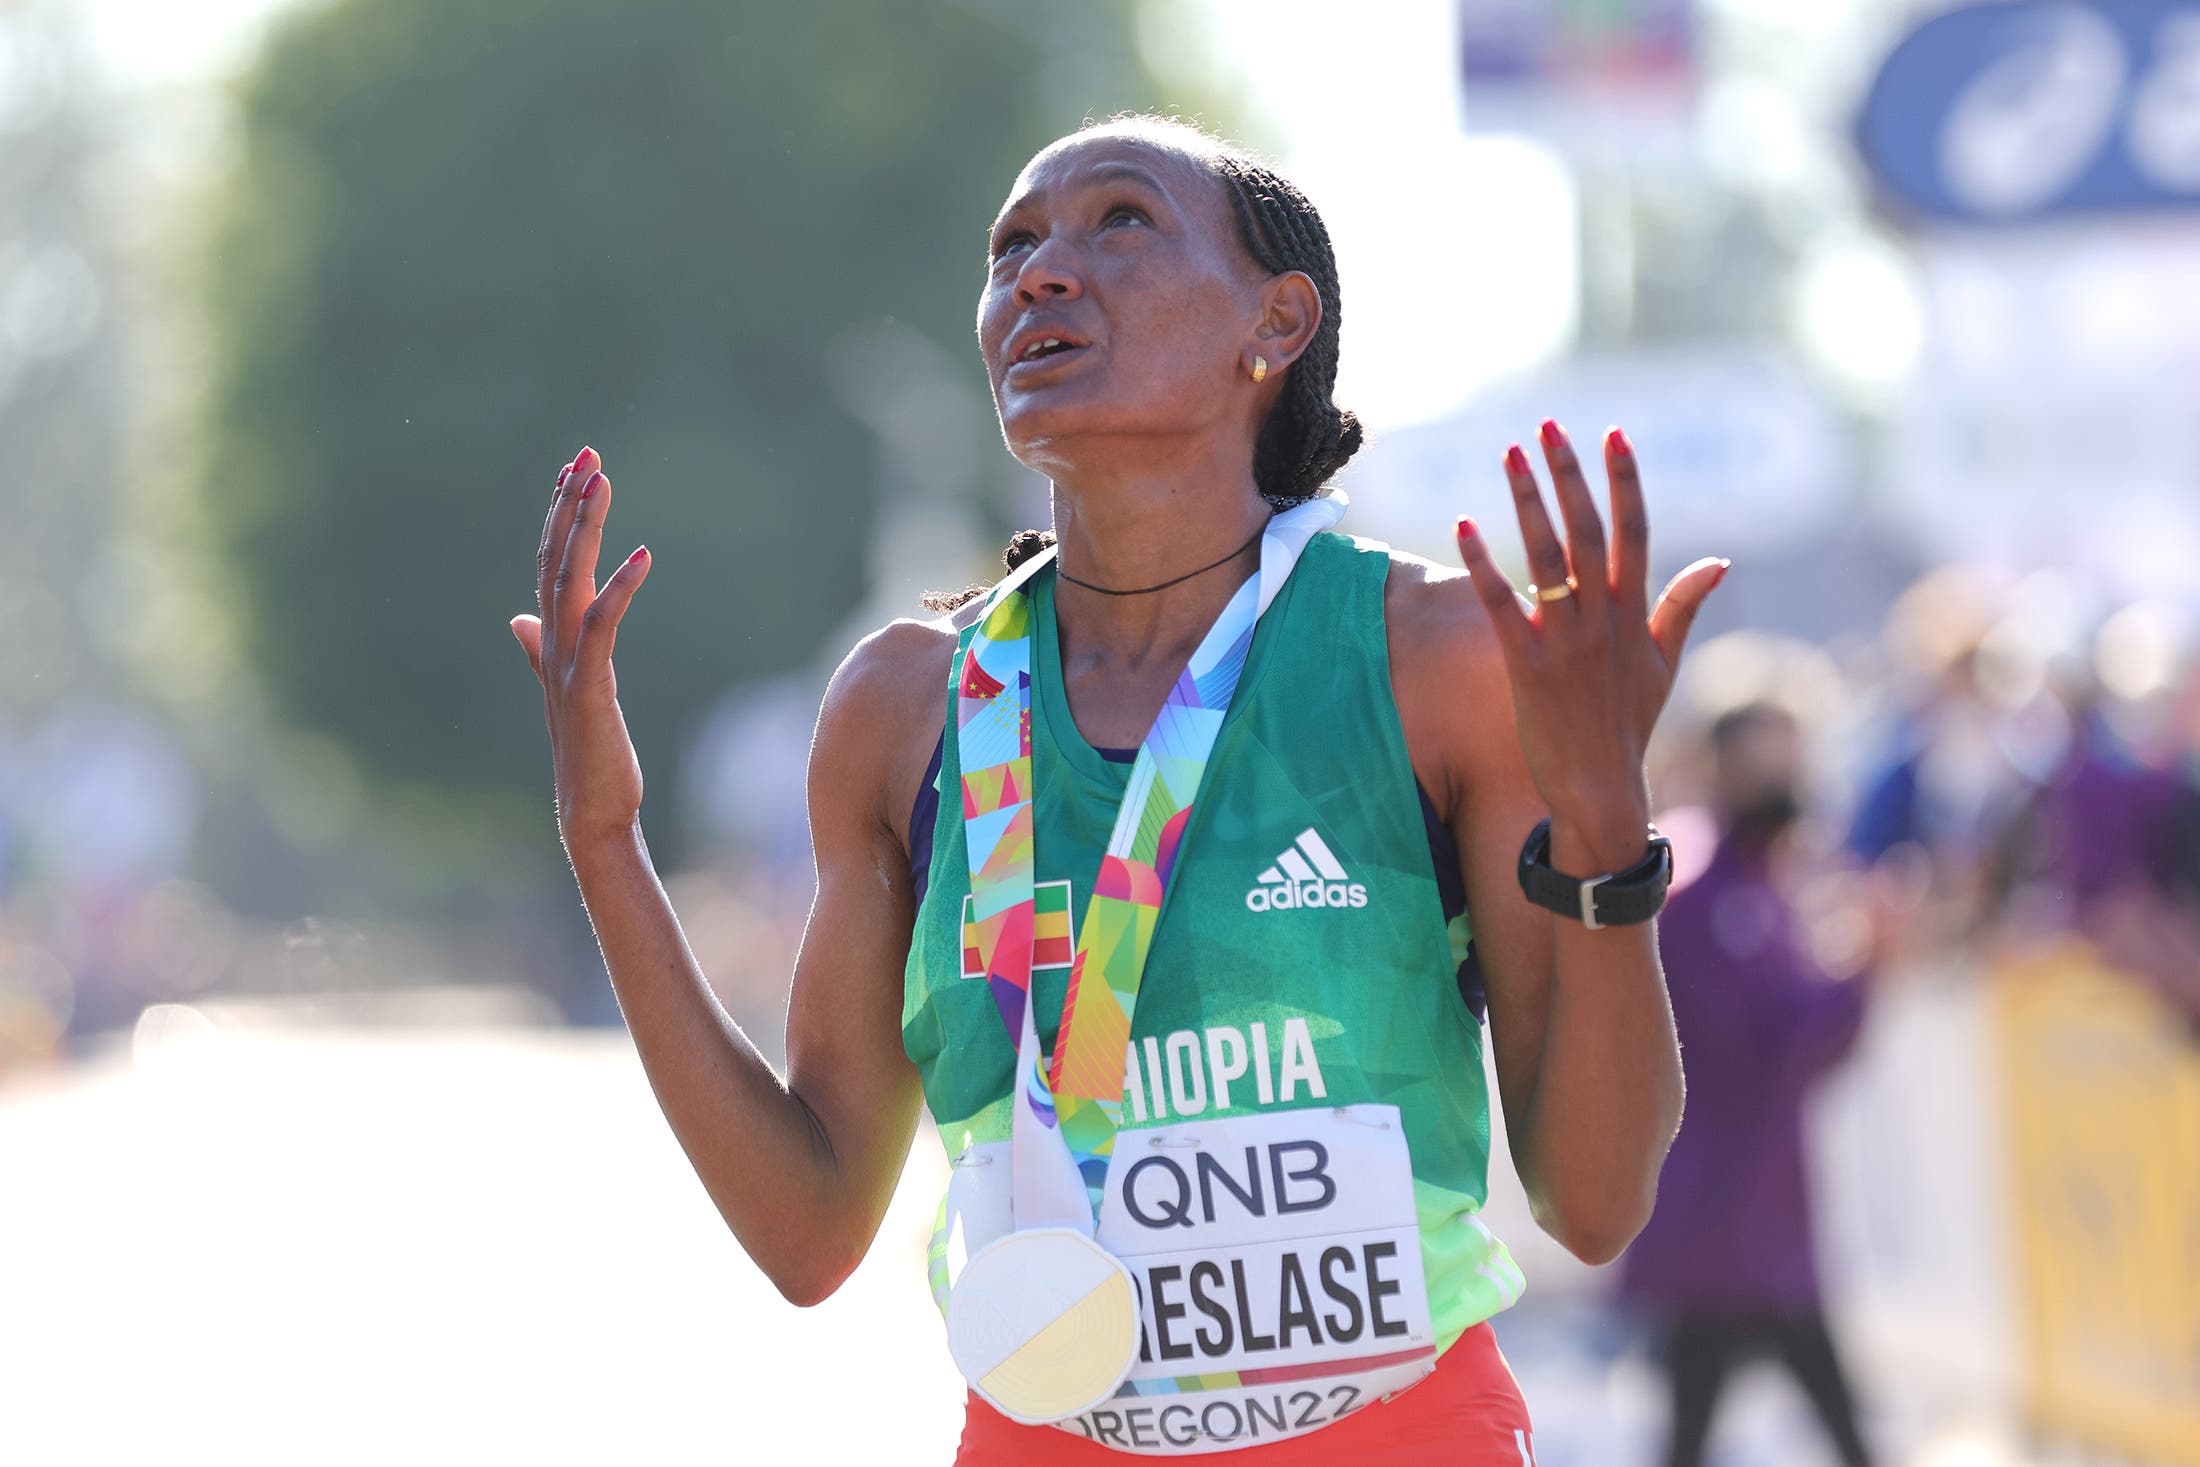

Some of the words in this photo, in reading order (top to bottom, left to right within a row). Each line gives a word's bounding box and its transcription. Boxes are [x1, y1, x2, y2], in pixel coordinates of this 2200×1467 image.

[1246, 877, 1368, 912] adidas
[1119, 1017, 1328, 1125] HIOPIA
[1122, 1140, 1337, 1229] QNB
[1131, 1241, 1408, 1363] ESLASE
